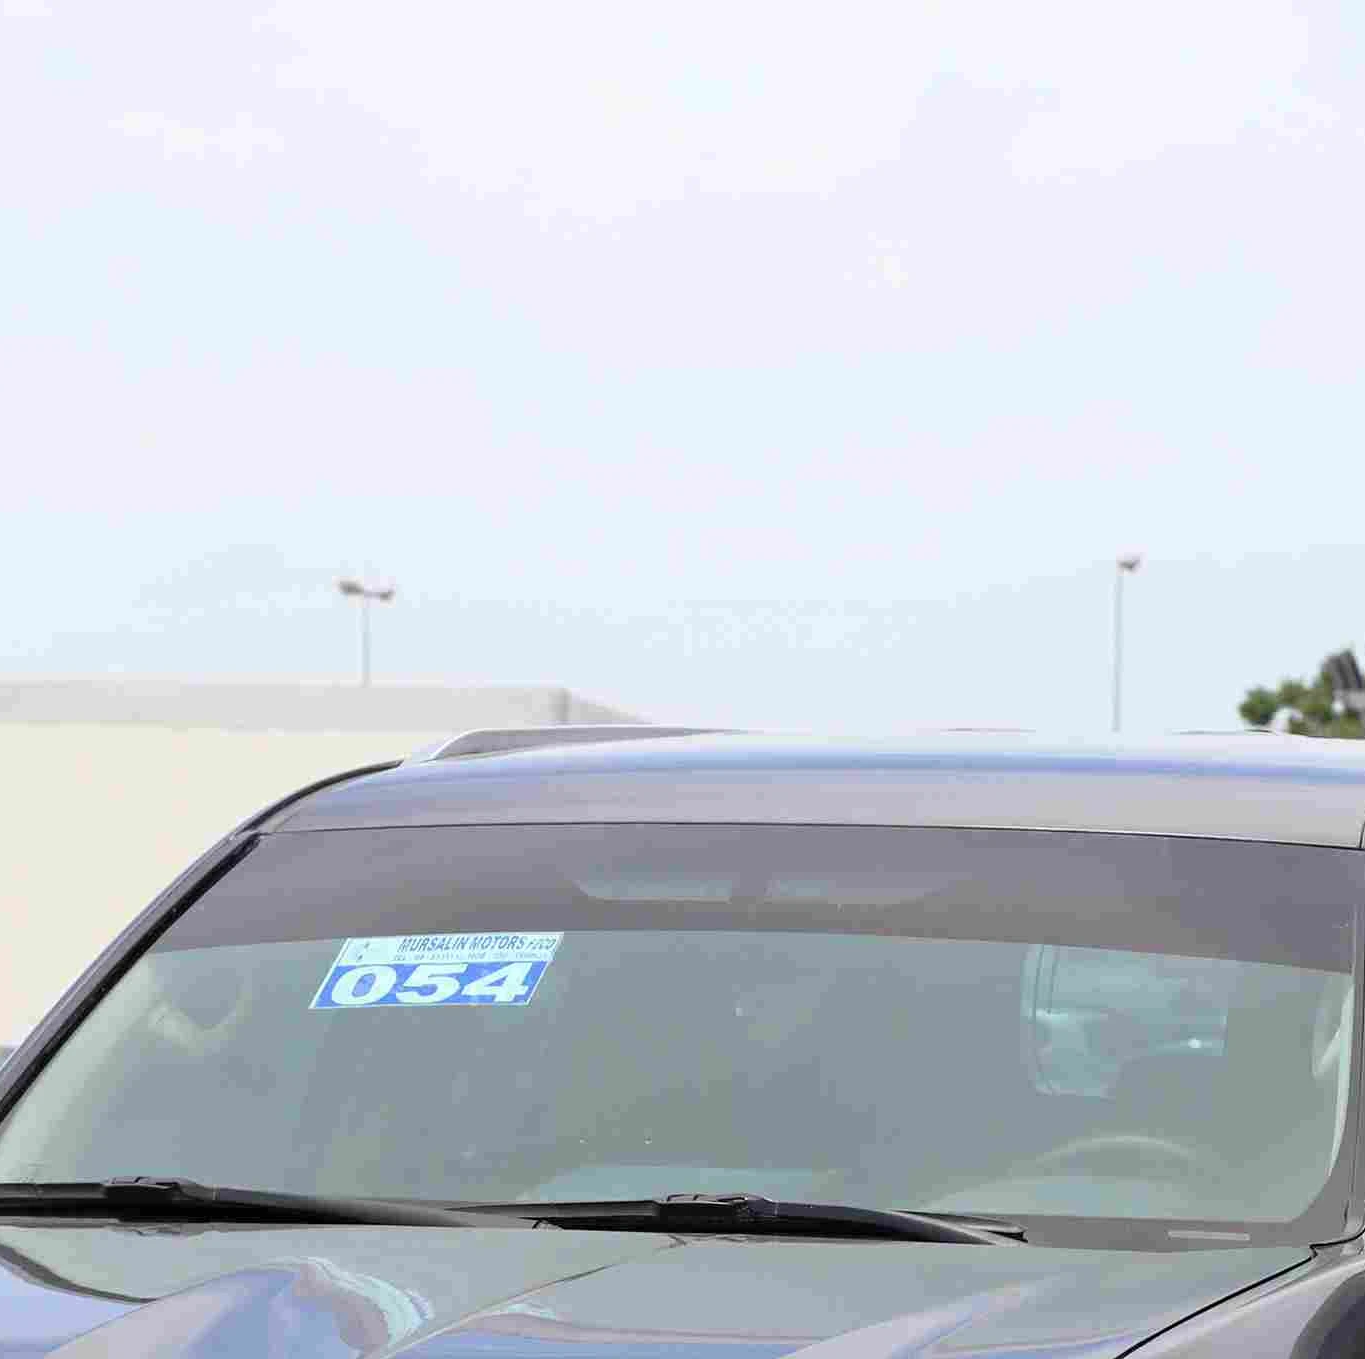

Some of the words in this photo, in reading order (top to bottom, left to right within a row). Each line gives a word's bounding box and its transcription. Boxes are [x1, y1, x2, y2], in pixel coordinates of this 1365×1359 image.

[397, 935, 468, 953] MURSALIN
[468, 934, 527, 951] MOTORS
[330, 961, 534, 1006] 054
